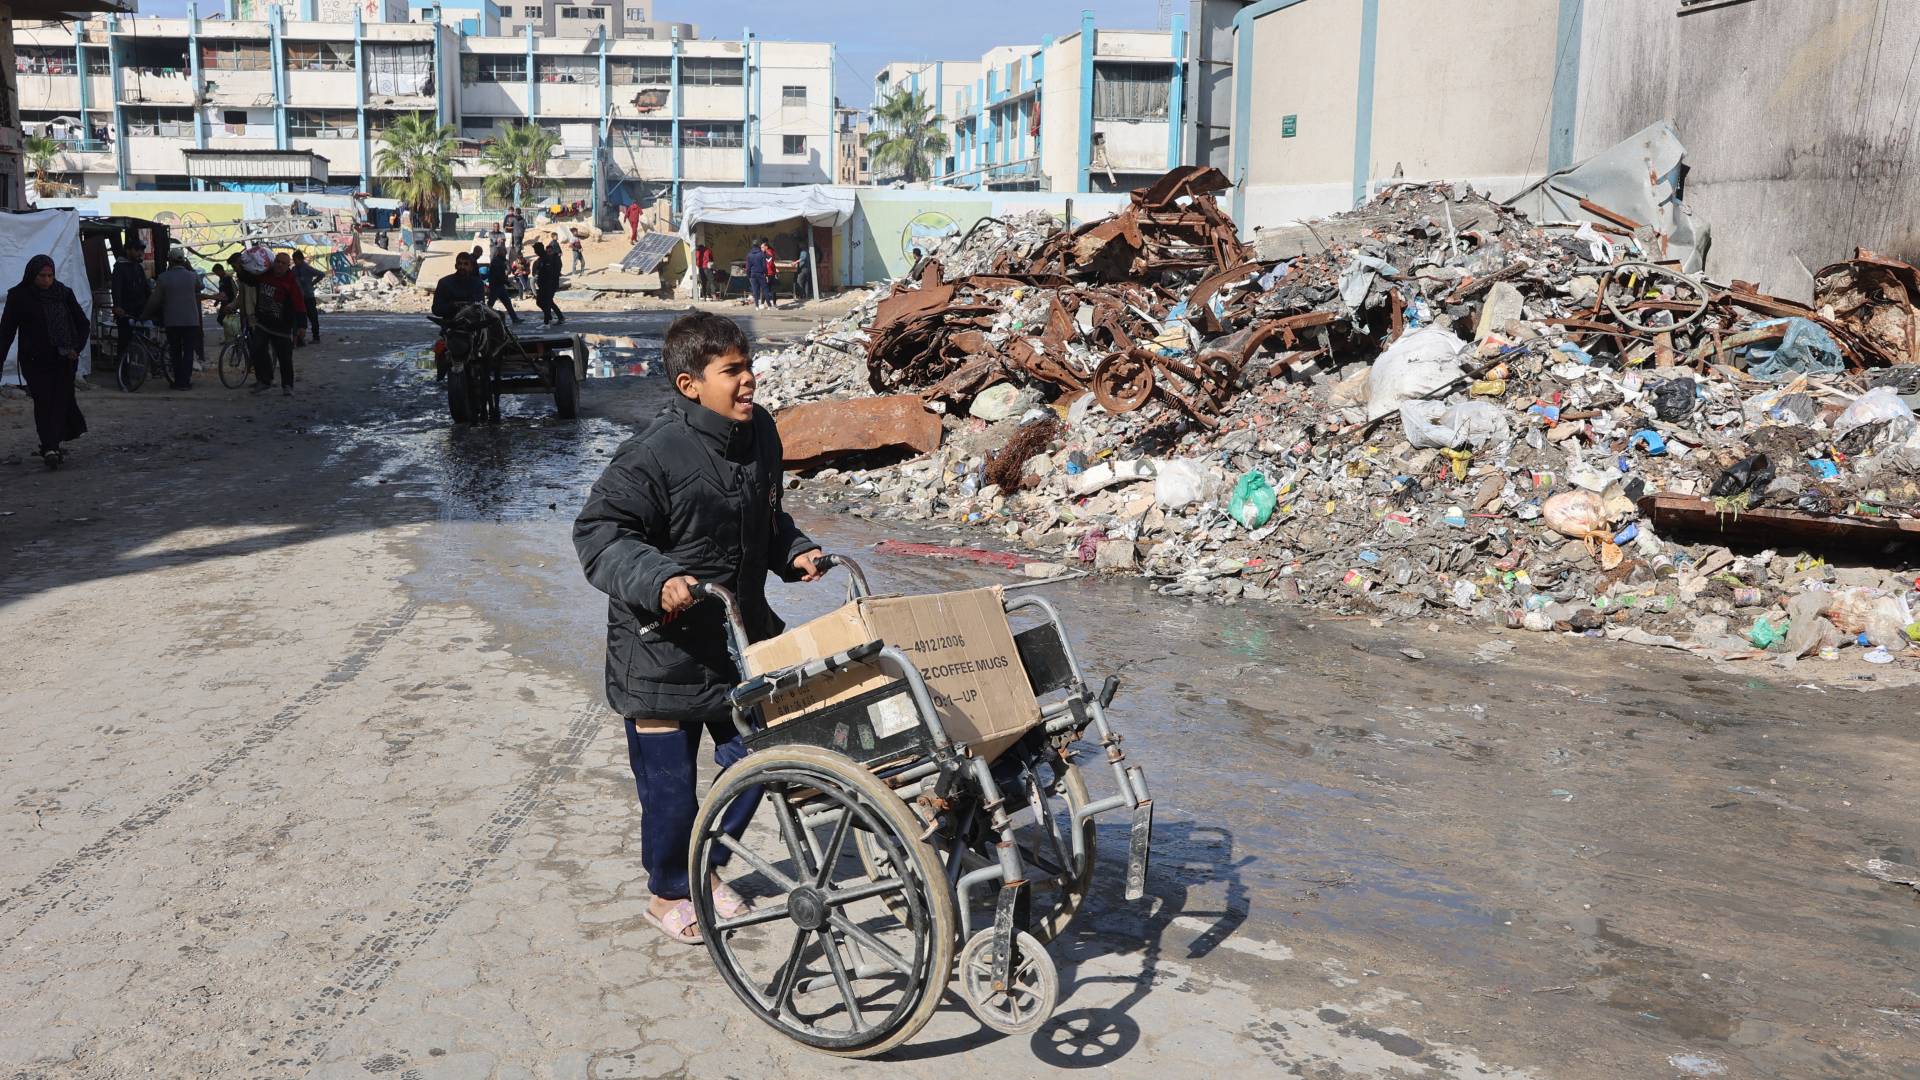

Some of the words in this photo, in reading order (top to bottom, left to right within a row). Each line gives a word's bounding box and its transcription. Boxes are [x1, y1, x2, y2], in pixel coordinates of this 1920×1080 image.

[894, 635, 966, 653] —4912/2006
[932, 661, 975, 679] COFFEE
[975, 655, 1009, 672] MUGS
